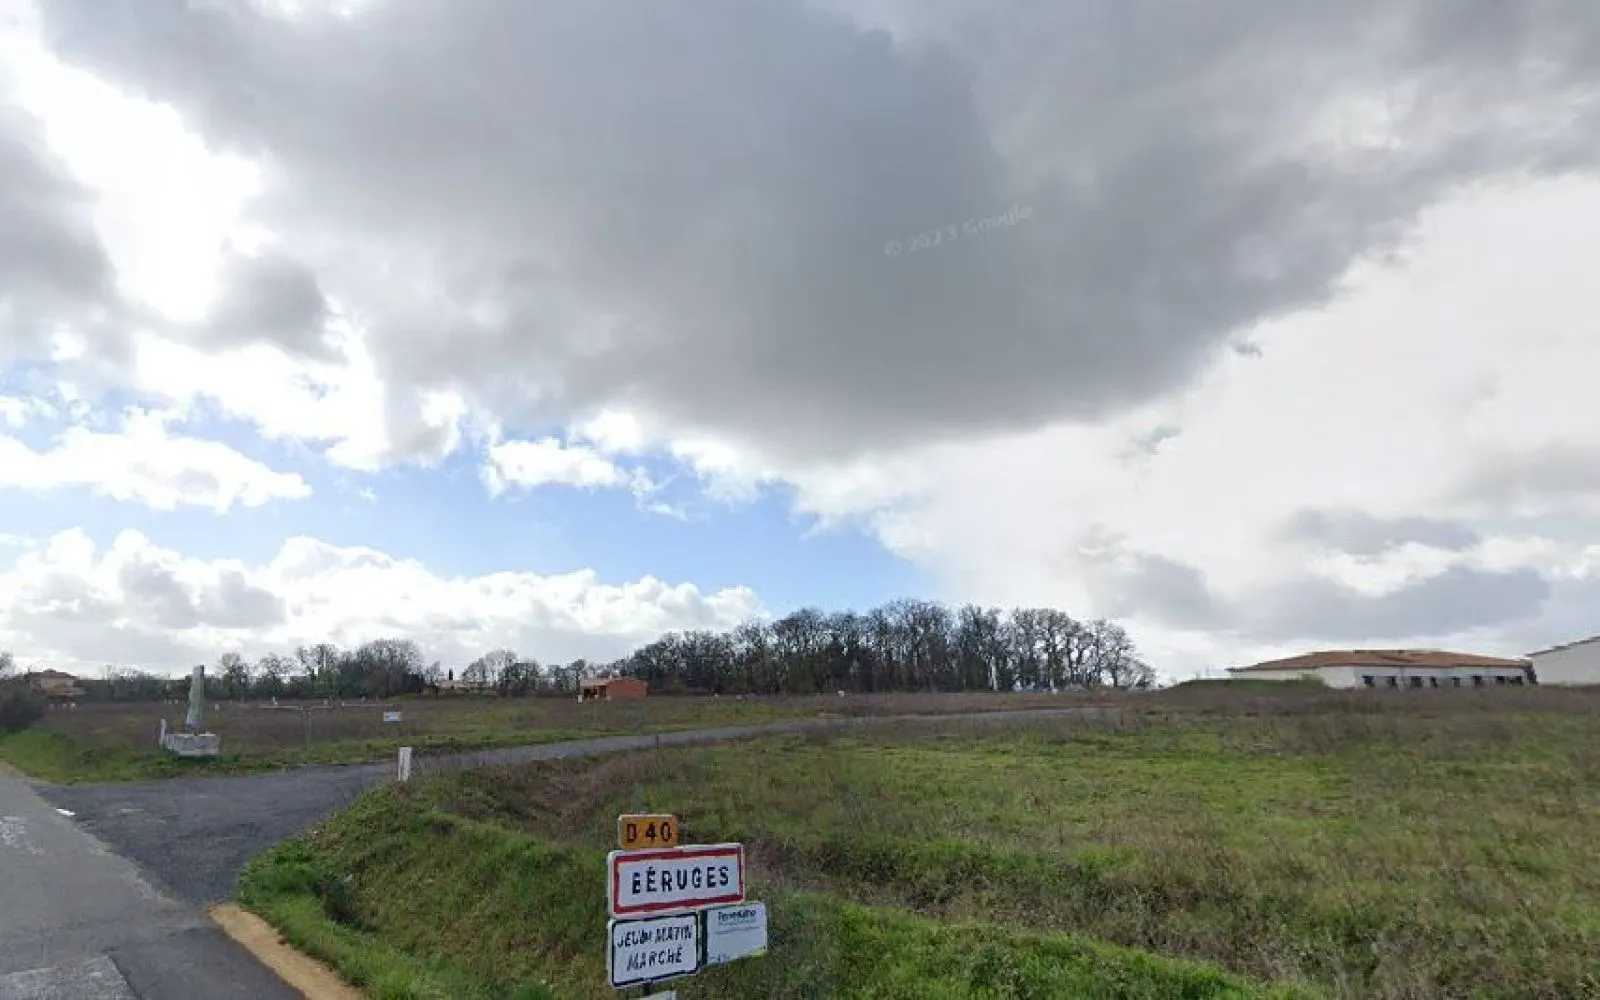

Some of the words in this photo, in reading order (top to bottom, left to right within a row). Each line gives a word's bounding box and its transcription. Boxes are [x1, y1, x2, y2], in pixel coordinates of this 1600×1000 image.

[626, 823, 637, 843] D
[645, 821, 673, 843] 40
[631, 865, 730, 895] BÉRUGES
[654, 924, 693, 945] MATIN
[626, 944, 684, 972] MARCHÉ
